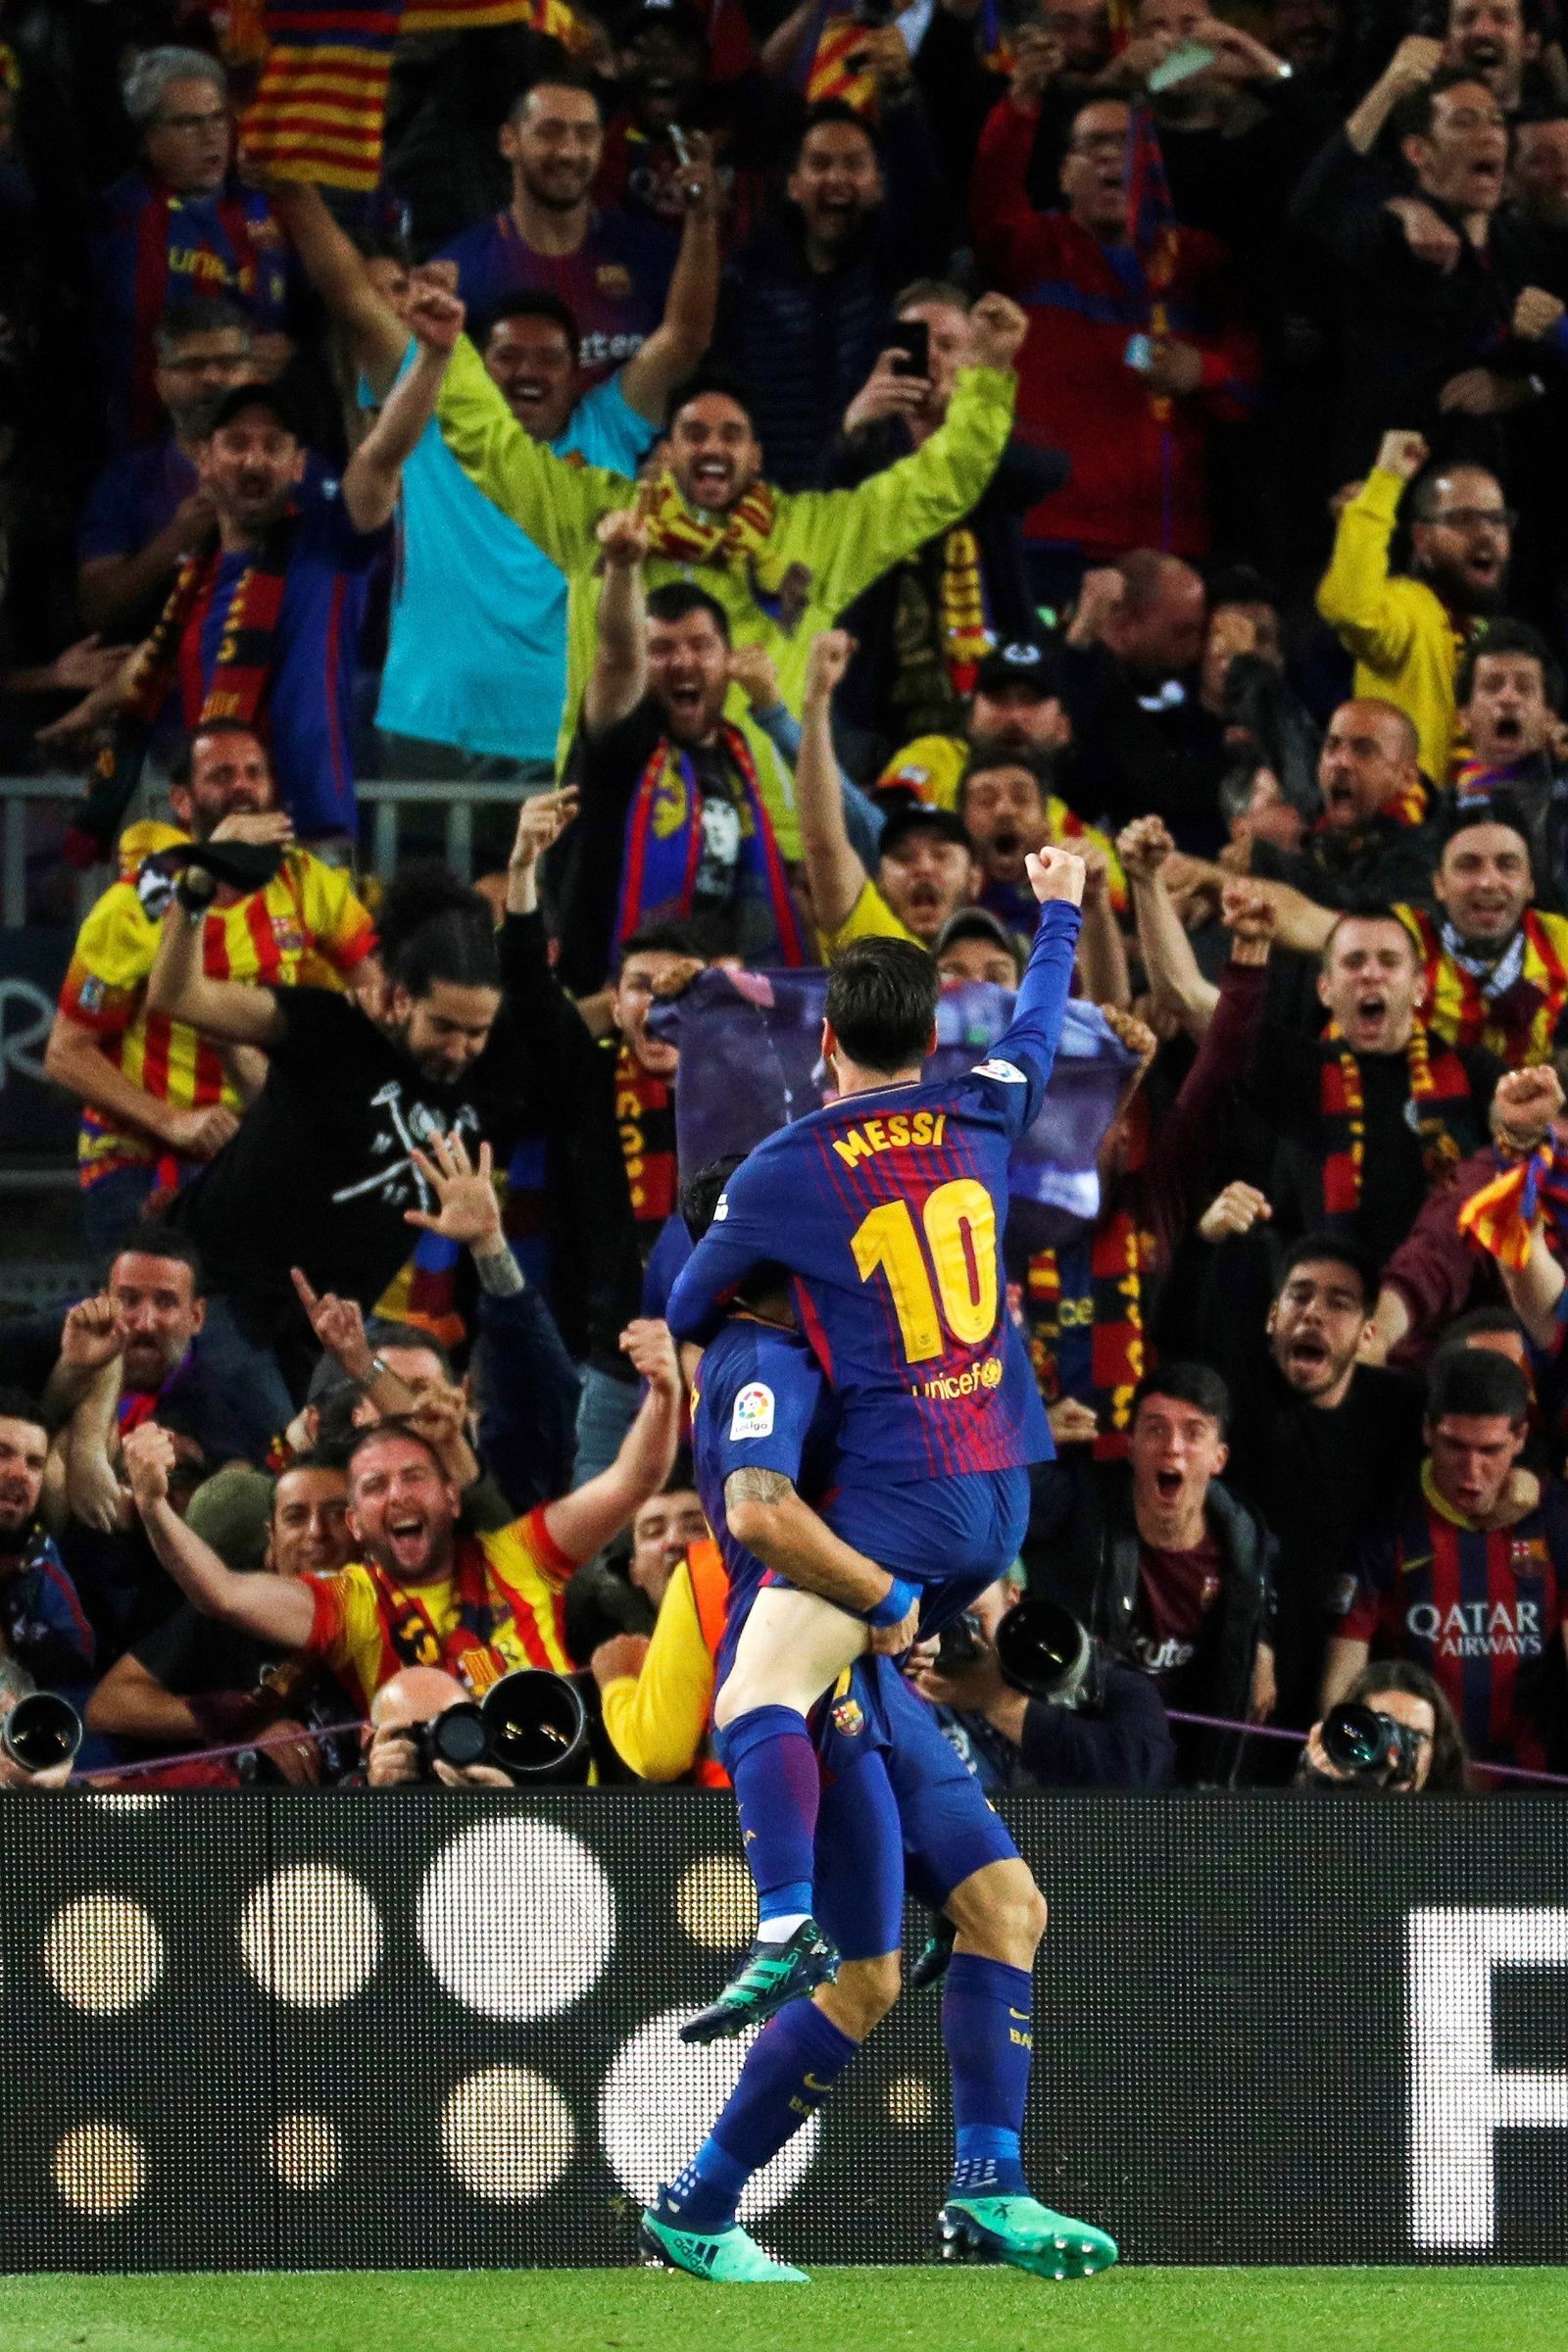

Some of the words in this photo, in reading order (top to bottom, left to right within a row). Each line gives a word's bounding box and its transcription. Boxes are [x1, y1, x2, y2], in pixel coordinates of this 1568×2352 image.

[833, 1111, 947, 1168] MESSI
[850, 1178, 999, 1364] 10
[1405, 1600, 1540, 1642] QATAR
[1441, 1635, 1543, 1657] AIRWAYS
